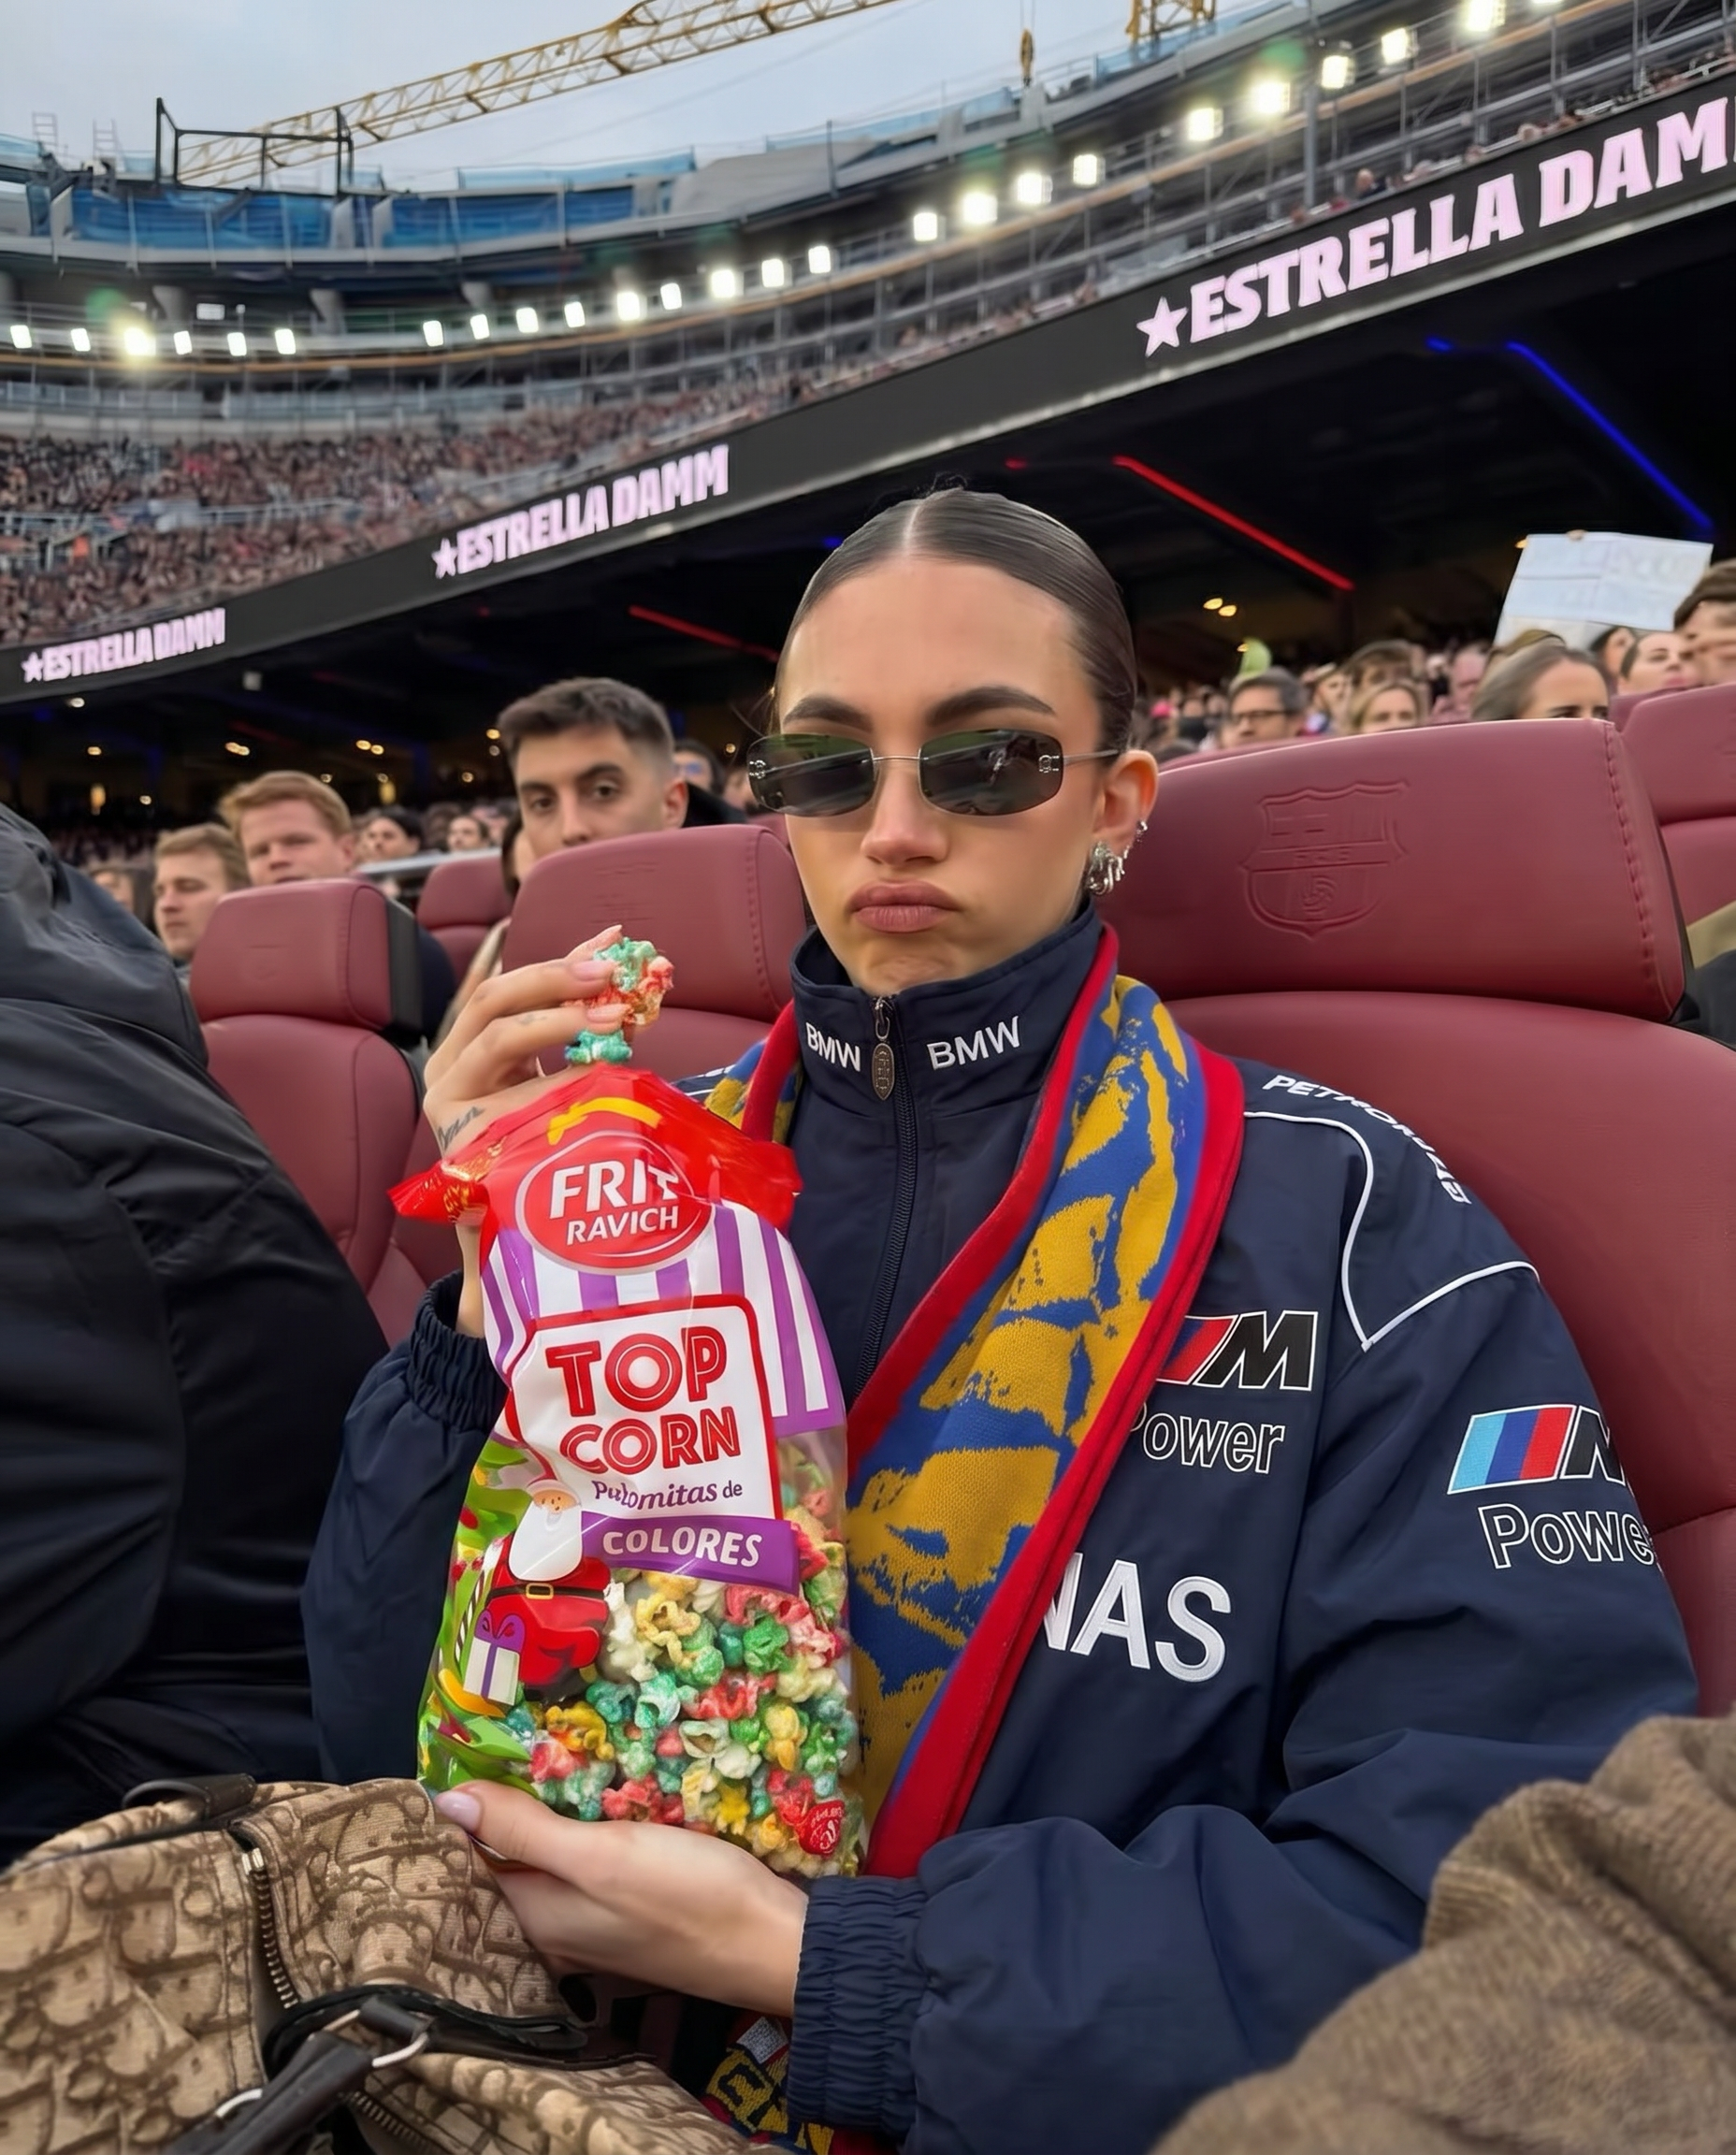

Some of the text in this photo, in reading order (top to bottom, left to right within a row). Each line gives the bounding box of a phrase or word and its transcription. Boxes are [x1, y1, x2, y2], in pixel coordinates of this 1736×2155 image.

[1190, 96, 1736, 343] ESTRELLA DAM
[456, 444, 729, 574] ESTRELLA DAMM
[42, 608, 225, 682] ESTRELLA DAMM
[805, 1022, 861, 1072] BMW
[927, 1016, 1020, 1070] BMW
[567, 1206, 679, 1246] RAVICH
[544, 1325, 728, 1418] TOP
[559, 1406, 741, 1475] CORN
[1131, 1402, 1285, 1474] ower
[722, 1480, 744, 1498] de
[602, 1526, 762, 1568] COLORES
[1478, 1503, 1664, 1578] Powe
